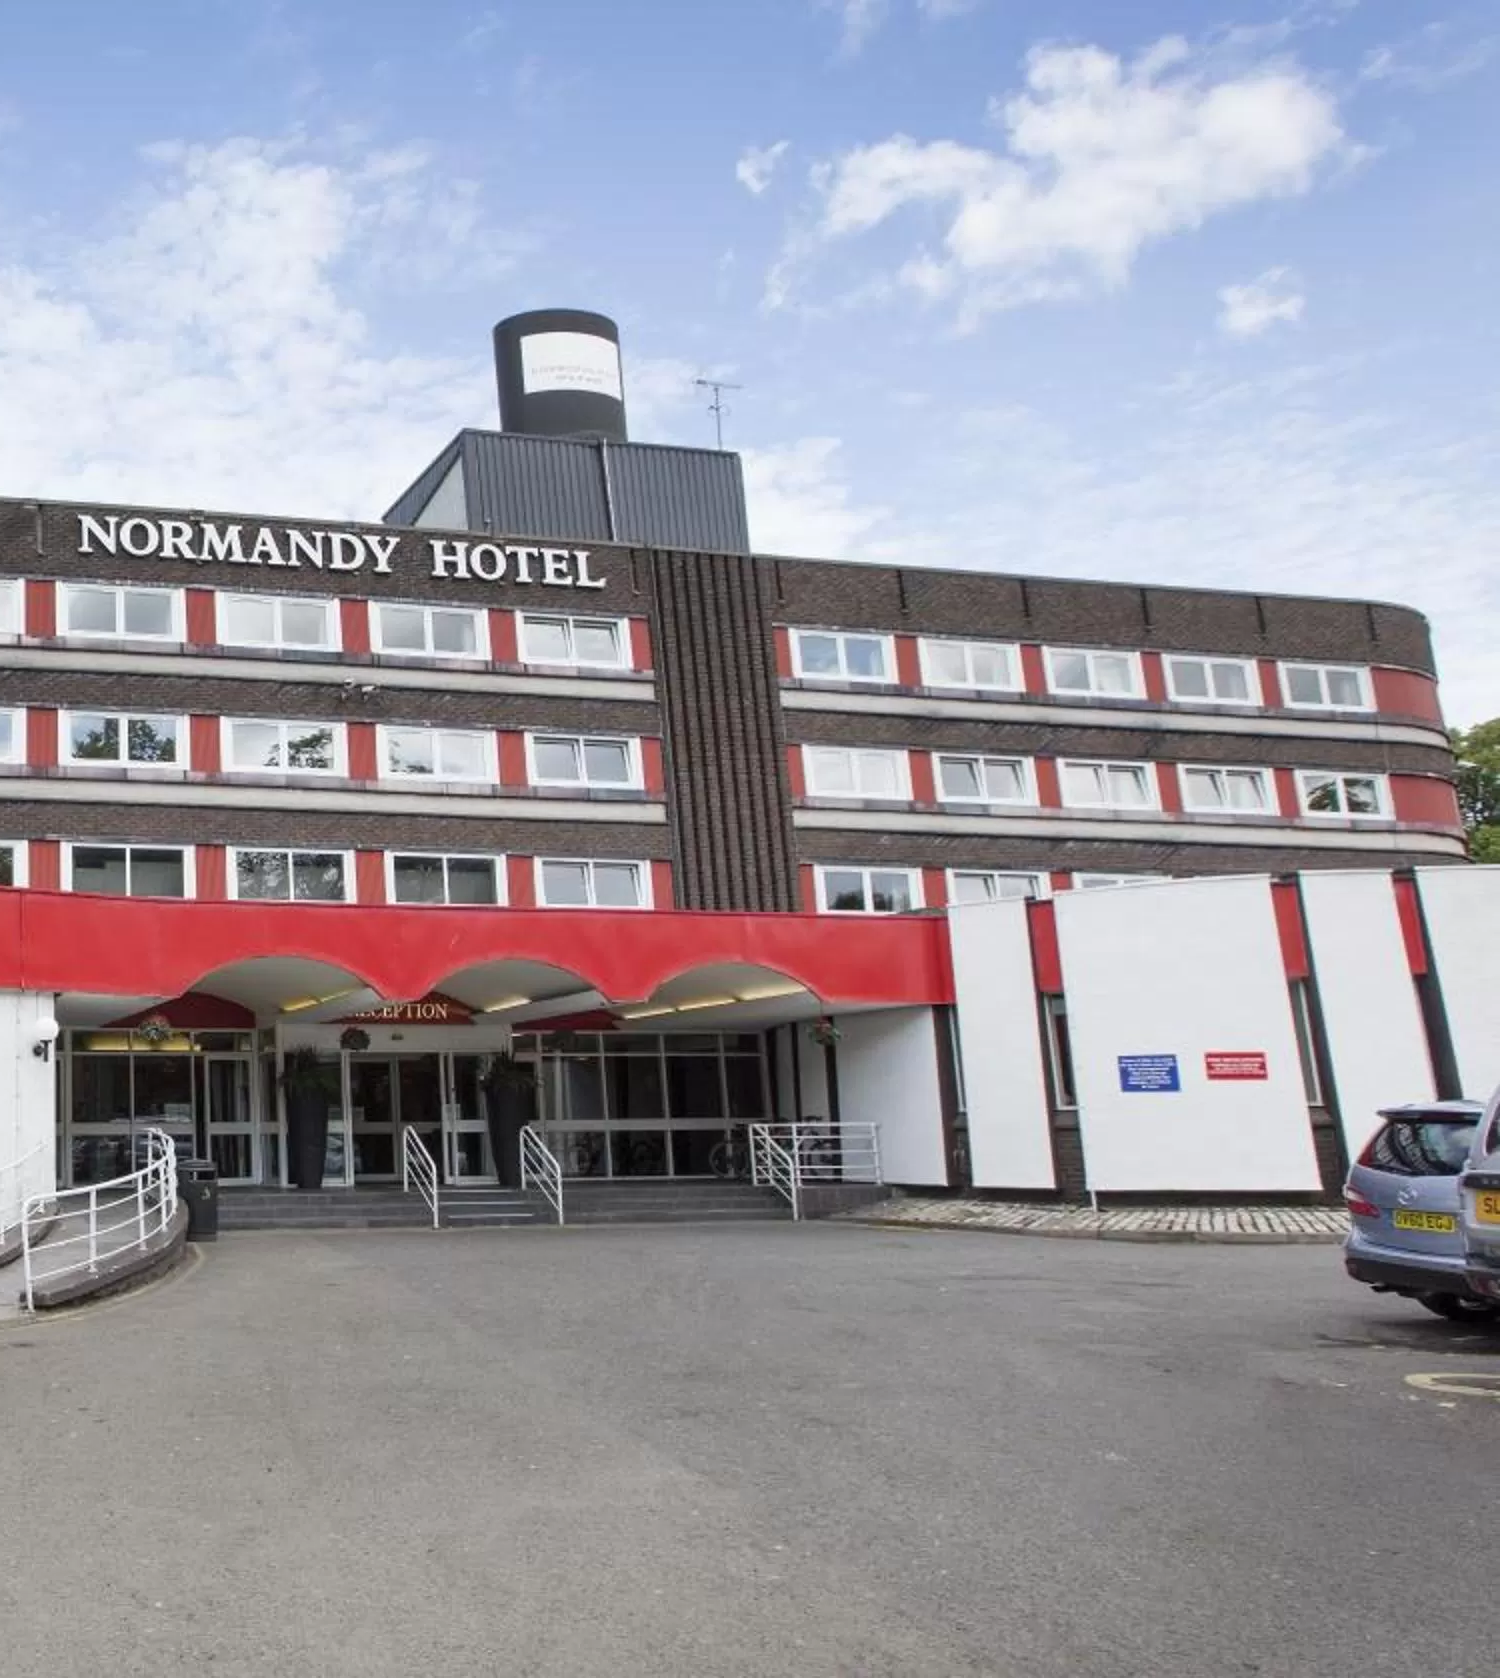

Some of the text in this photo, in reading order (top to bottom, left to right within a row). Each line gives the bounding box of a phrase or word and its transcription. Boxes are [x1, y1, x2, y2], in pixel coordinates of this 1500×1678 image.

[77, 513, 606, 588] NORMANDY HOTEL
[355, 1003, 449, 1019] CEPTION
